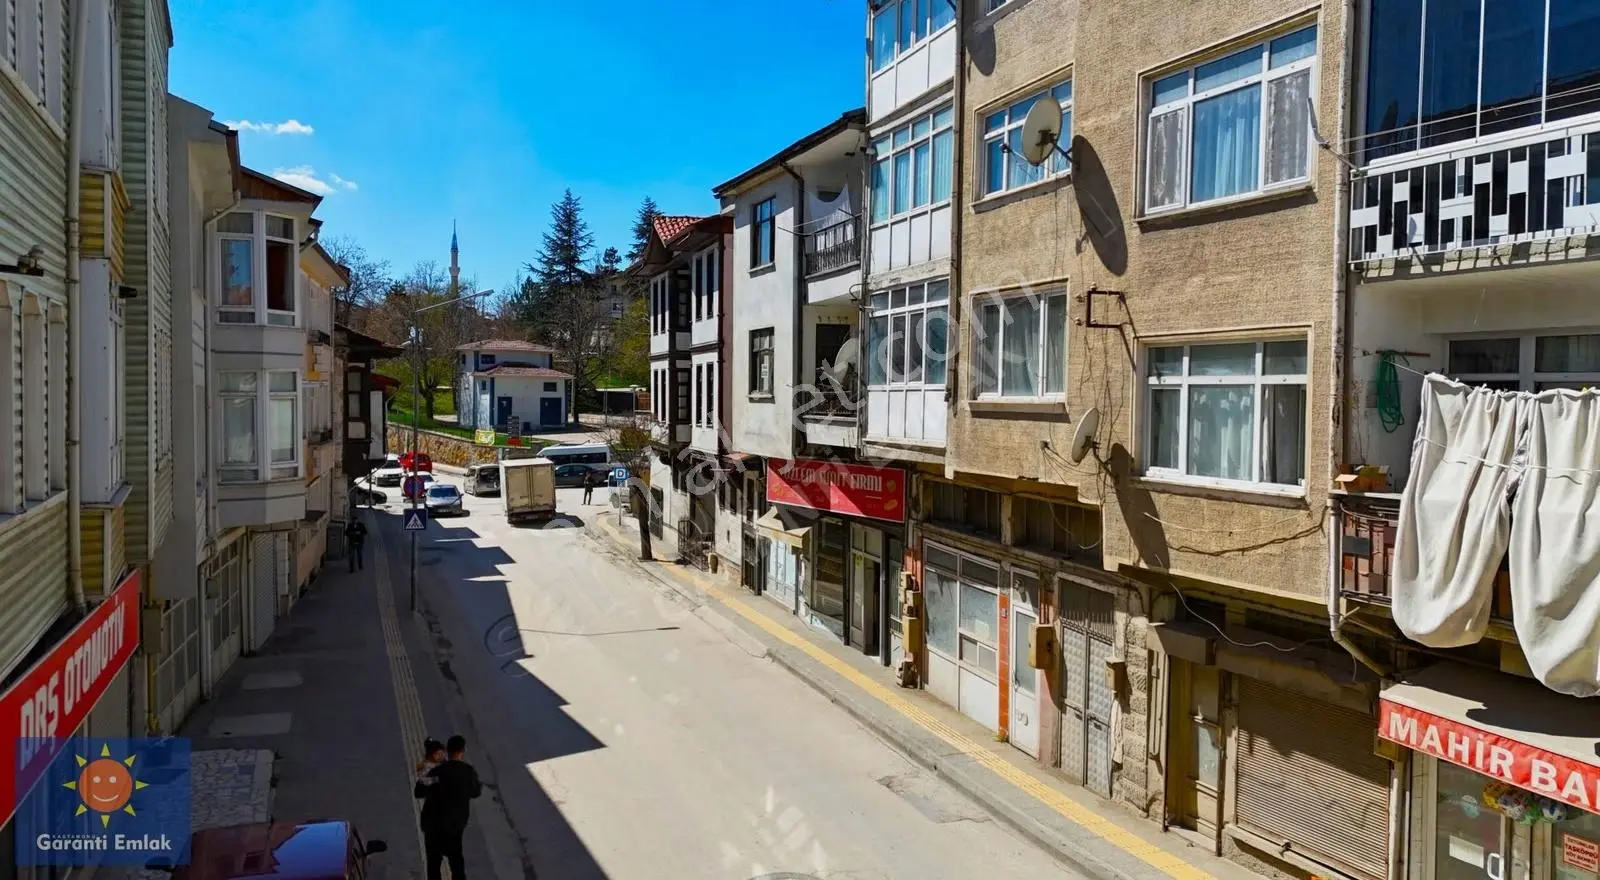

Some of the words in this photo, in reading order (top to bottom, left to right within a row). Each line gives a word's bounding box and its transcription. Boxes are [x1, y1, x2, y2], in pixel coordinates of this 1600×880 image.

[64, 594, 125, 716] OTOMOTİV
[1389, 712, 1515, 780] MAHİR
[1531, 758, 1600, 809] BA
